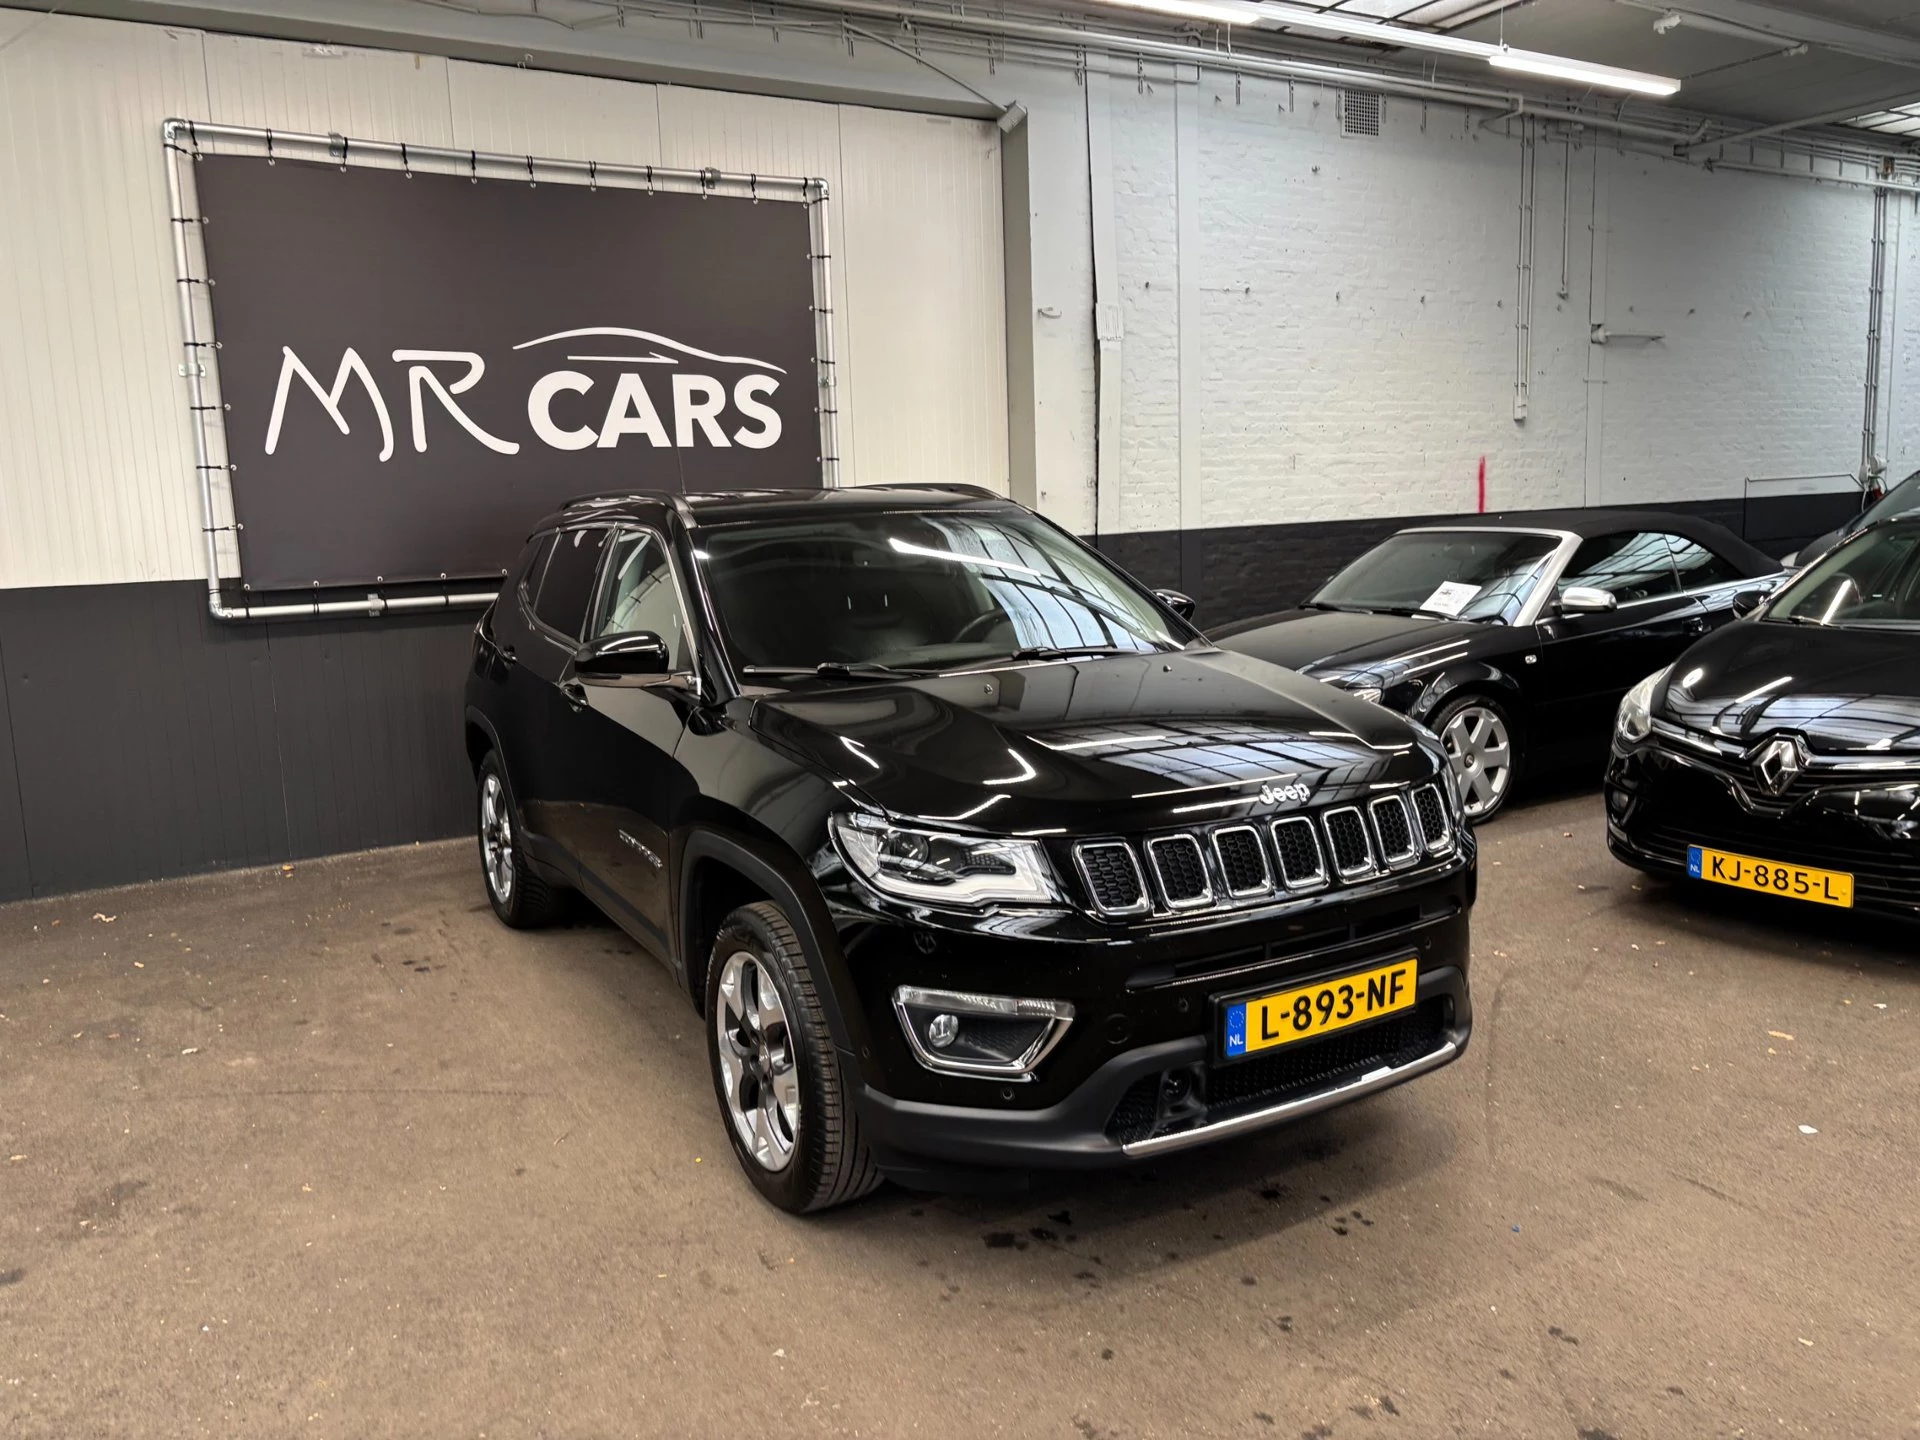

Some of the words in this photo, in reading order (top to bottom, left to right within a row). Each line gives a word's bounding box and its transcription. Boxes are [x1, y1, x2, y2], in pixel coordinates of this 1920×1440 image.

[265, 345, 520, 462] MR
[527, 370, 783, 451] CARS
[1259, 783, 1311, 805] Jeep
[1690, 863, 1700, 873] NL
[1712, 855, 1839, 901] KJ-885-L
[1261, 968, 1407, 1041] L-893-NF
[1229, 1033, 1244, 1047] NL
